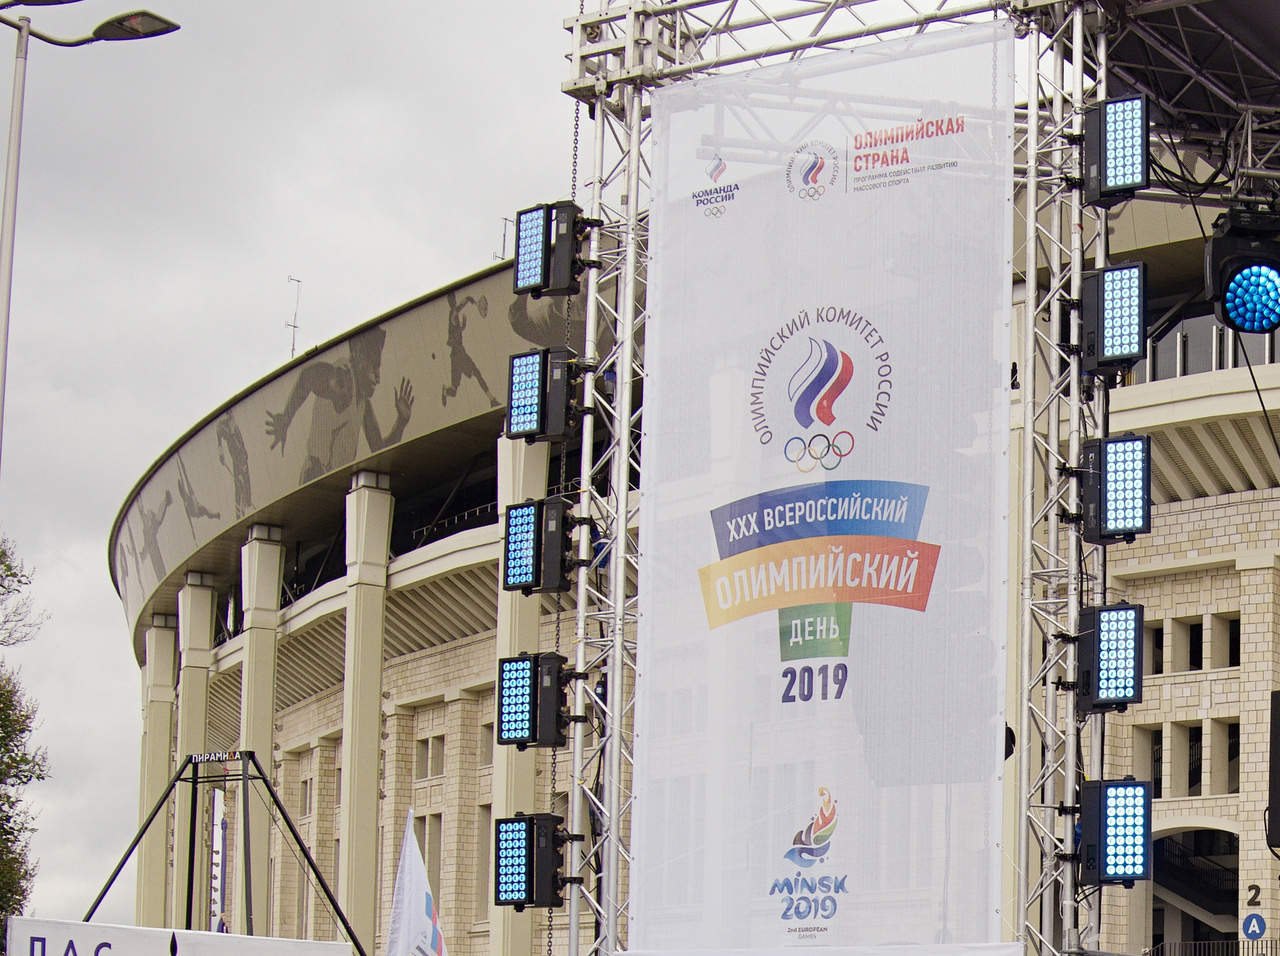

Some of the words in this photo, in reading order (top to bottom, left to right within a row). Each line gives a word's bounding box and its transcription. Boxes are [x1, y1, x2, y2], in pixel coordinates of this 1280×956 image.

[853, 116, 965, 150] ОЛИМПИЙСКАЯ
[853, 146, 910, 172] СТРАНА
[853, 172, 888, 183] ПРОГРАММА
[888, 165, 926, 178] СОДЕЙСТВИЯ
[926, 161, 958, 171] РАЗВИТИЮ
[691, 183, 740, 199] КОМАНДА
[853, 181, 887, 192] МАССОВОГО
[888, 178, 910, 187] СПОРТА
[695, 193, 735, 207] РОССИИ
[750, 309, 810, 445] ОЛИМПИЙСКИЙ
[816, 306, 884, 349] КОМИТЕТ
[866, 351, 893, 432] РОССИИ
[763, 492, 909, 531] ВСЕРОССИЙСКИЙ
[715, 545, 919, 610] ОЛИМПИЙСКИЙ
[789, 616, 840, 647] ДЕНЬ
[781, 663, 848, 703] 2019
[780, 895, 837, 920] 2019
[1247, 884, 1261, 906] 2
